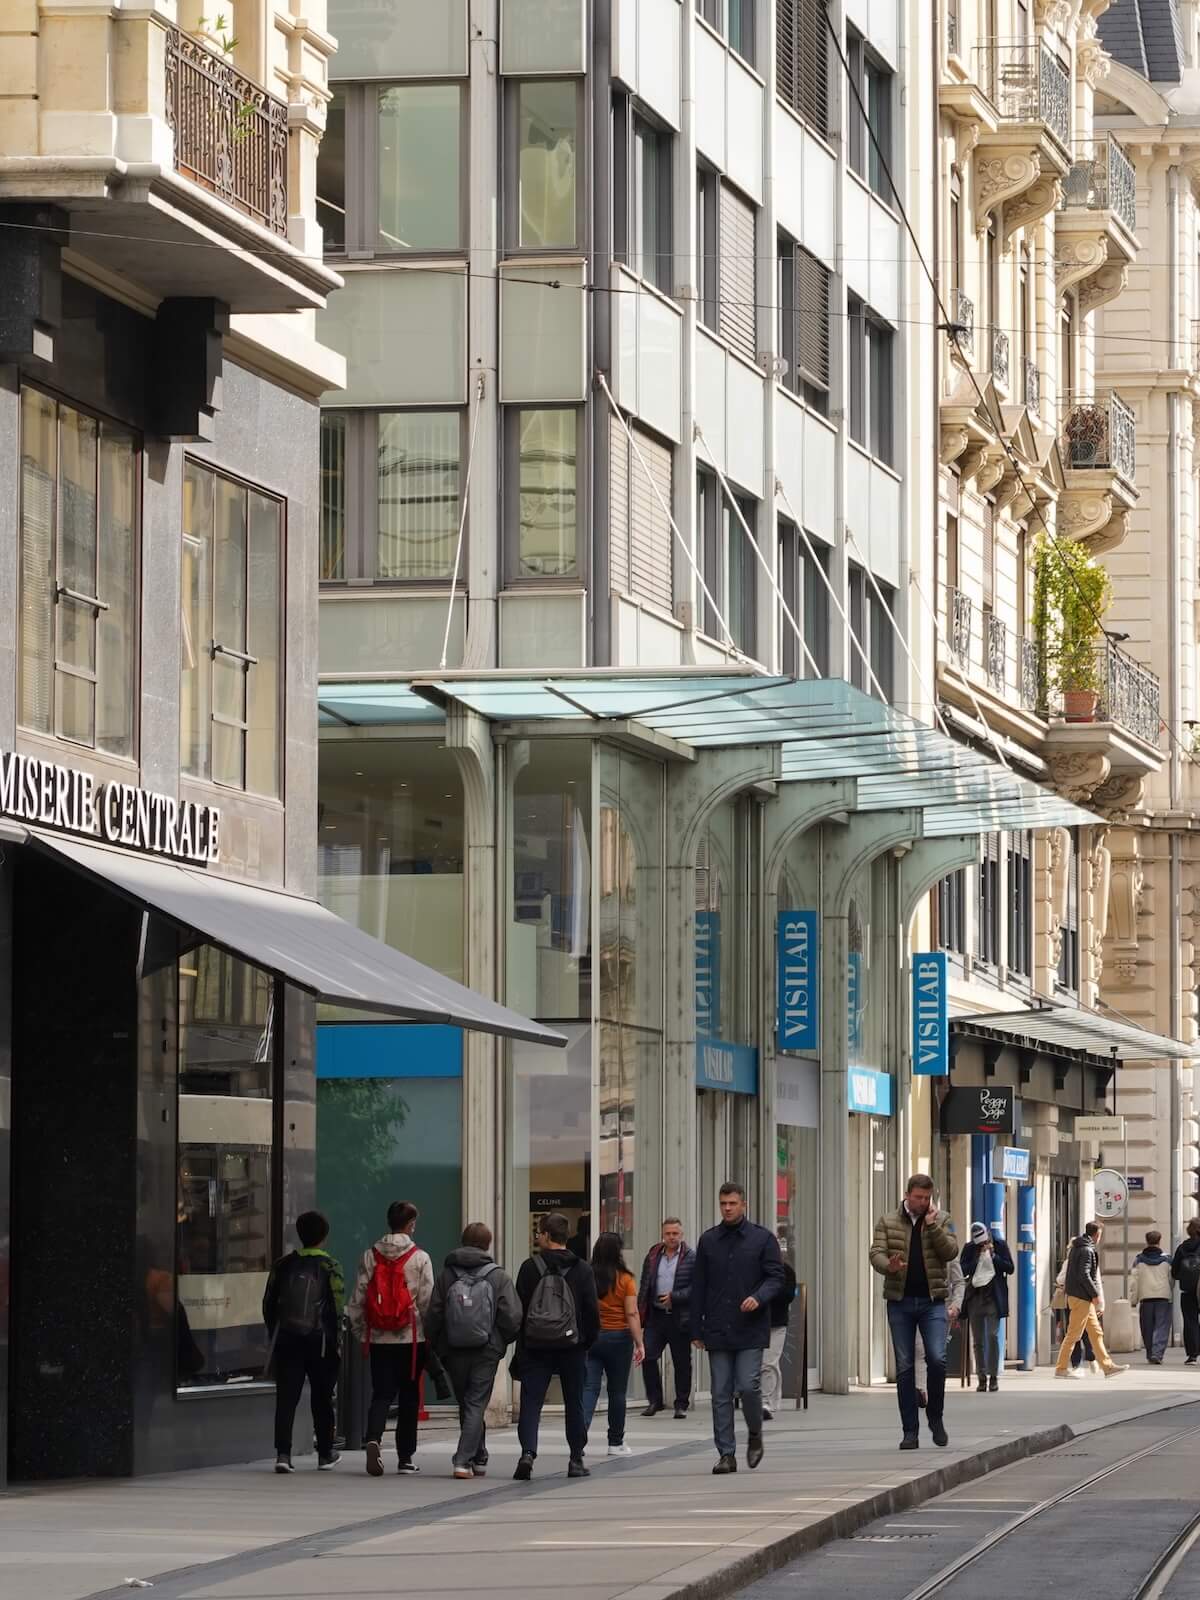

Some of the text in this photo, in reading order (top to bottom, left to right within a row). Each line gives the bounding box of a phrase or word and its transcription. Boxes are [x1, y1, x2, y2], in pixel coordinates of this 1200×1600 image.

[104, 779, 220, 864] CENTRALE
[785, 921, 808, 1039] VISILAB
[919, 961, 940, 1065] VISILAB
[980, 1089, 1008, 1109] Peggy
[980, 1105, 1006, 1120] Sage
